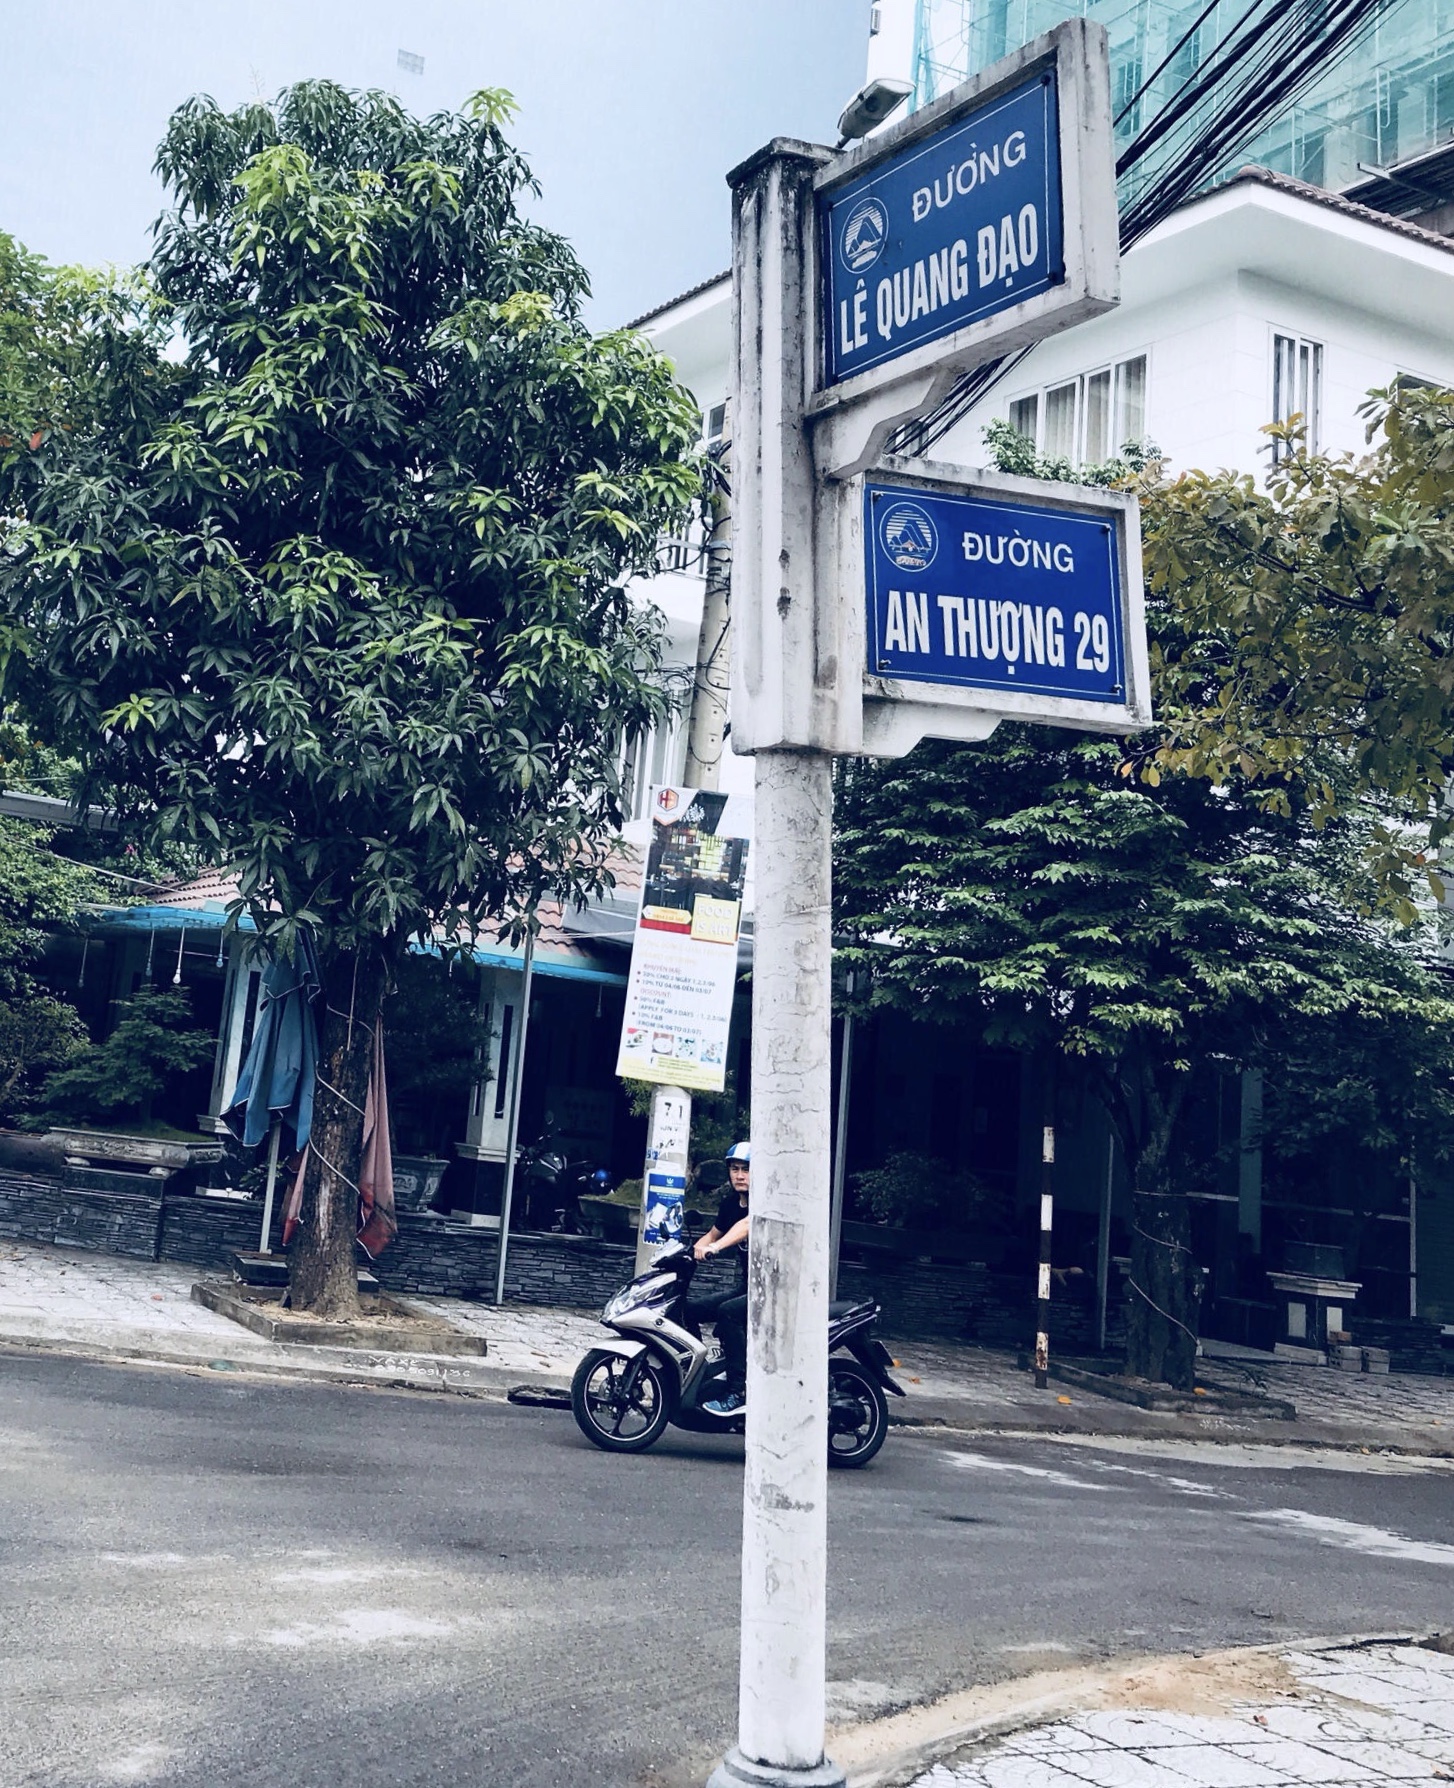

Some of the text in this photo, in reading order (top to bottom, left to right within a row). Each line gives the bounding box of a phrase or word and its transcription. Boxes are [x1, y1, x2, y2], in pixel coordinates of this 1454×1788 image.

[912, 130, 1027, 223] ĐƯỜNG
[840, 203, 1038, 355] LÊ QUANG ĐẠO
[962, 529, 1074, 573] ĐƯỜNG
[885, 590, 1109, 674] AN THƯỢNG 29
[696, 903, 733, 919] FOOD
[708, 921, 733, 937] ART
